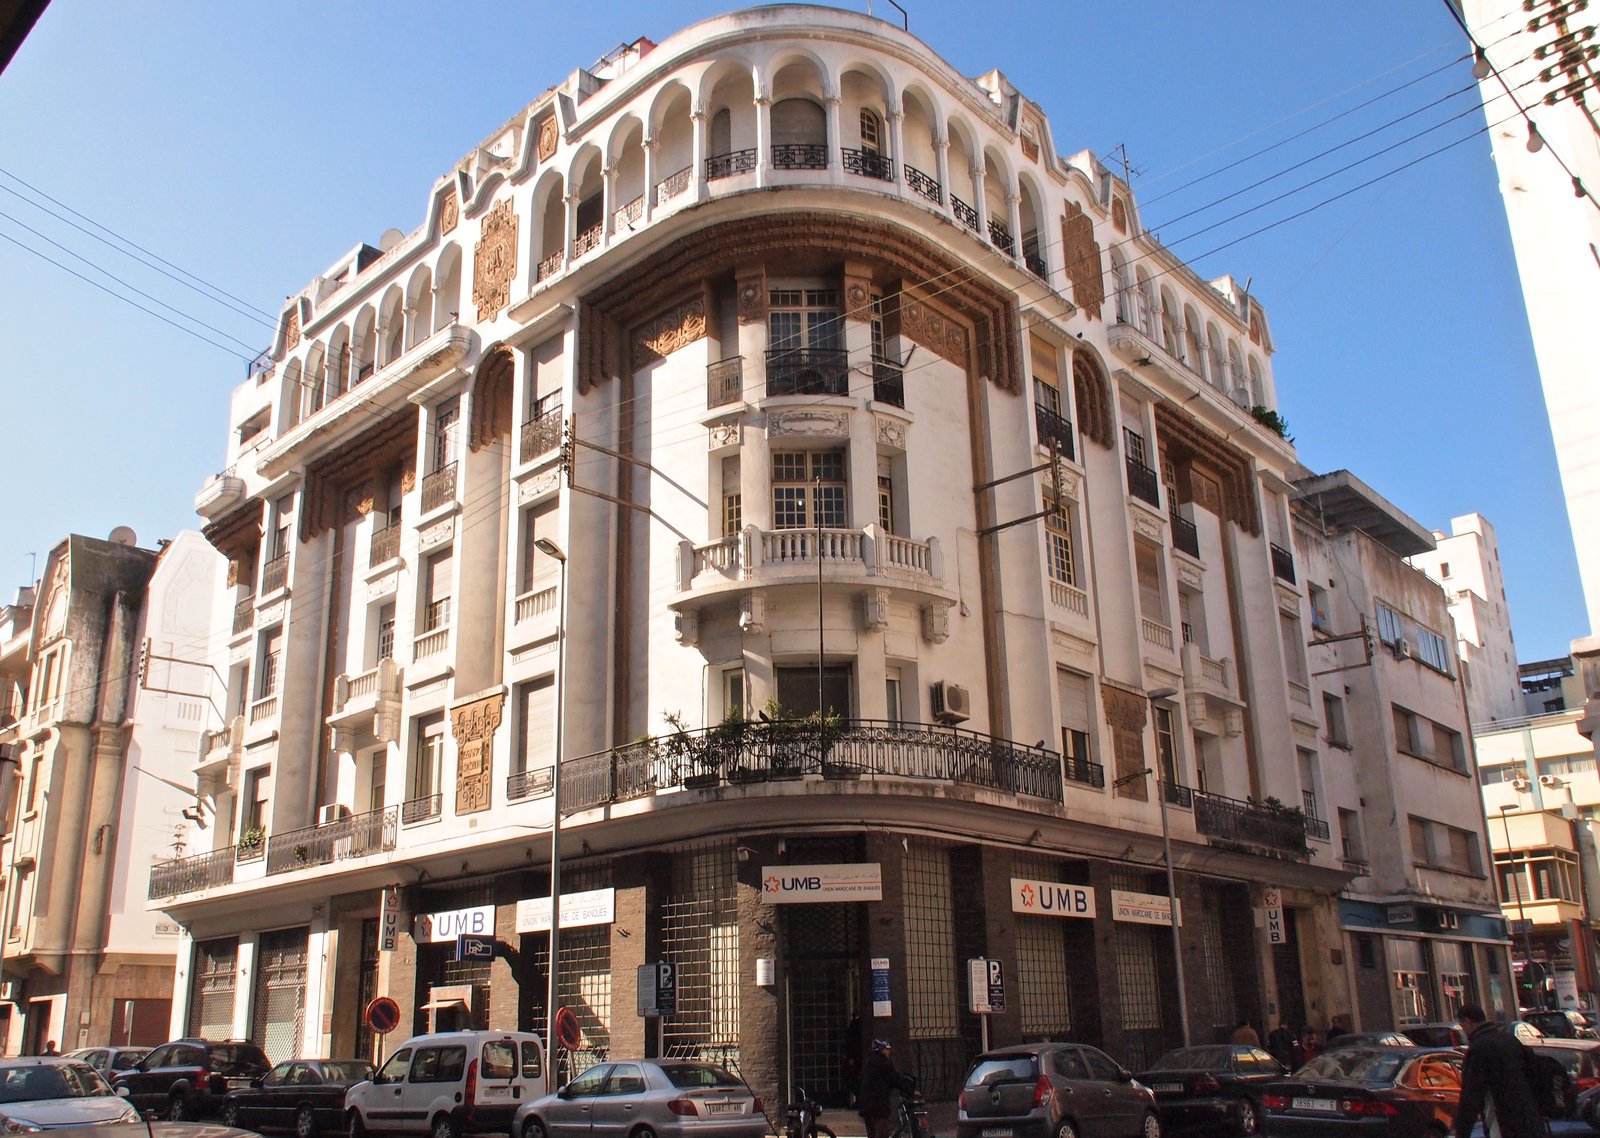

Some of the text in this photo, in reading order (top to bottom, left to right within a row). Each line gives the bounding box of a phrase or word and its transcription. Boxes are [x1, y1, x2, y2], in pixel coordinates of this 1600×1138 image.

[781, 876, 821, 890] UMB
[1039, 885, 1087, 913] UMB
[438, 911, 485, 936] UMB
[572, 911, 580, 921] DE
[1268, 910, 1280, 942] UMB
[385, 914, 396, 949] UMB
